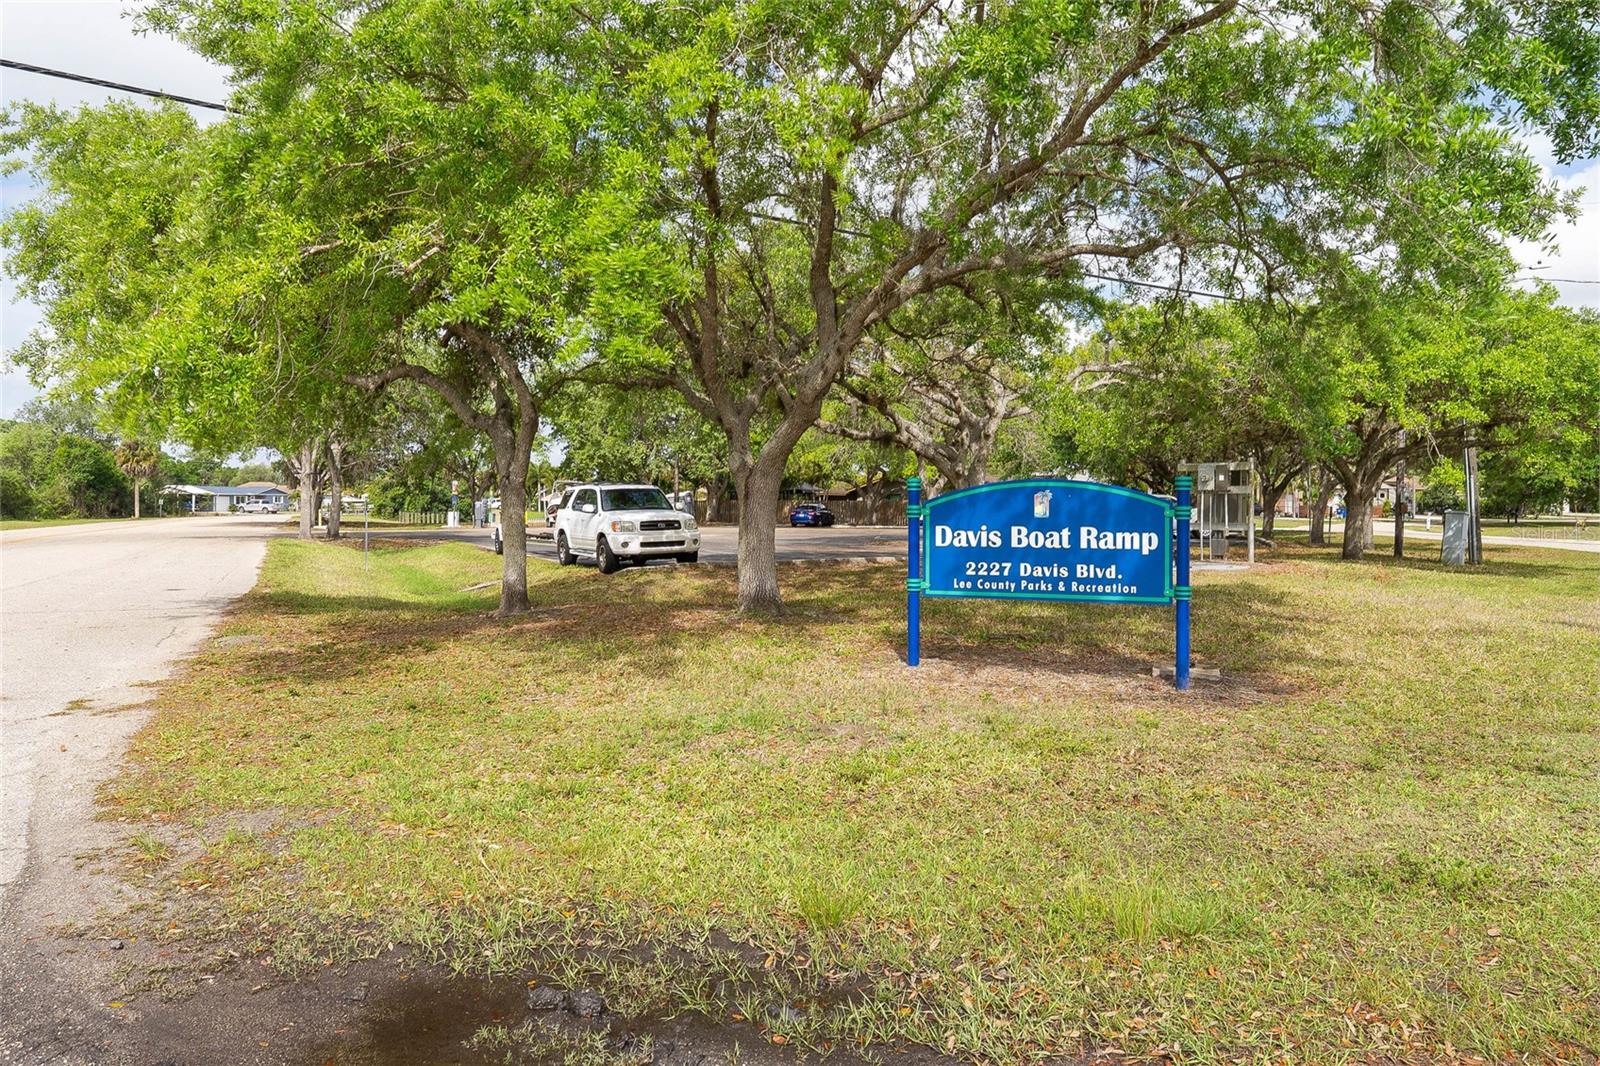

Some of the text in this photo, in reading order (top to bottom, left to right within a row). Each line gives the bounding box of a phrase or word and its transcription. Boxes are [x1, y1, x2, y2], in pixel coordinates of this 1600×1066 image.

[935, 524, 1159, 555] Davis Boat Ramp
[966, 561, 1123, 580] 2227 Davis Blvd.
[953, 578, 1138, 595] Lee County Parks & Recreation
